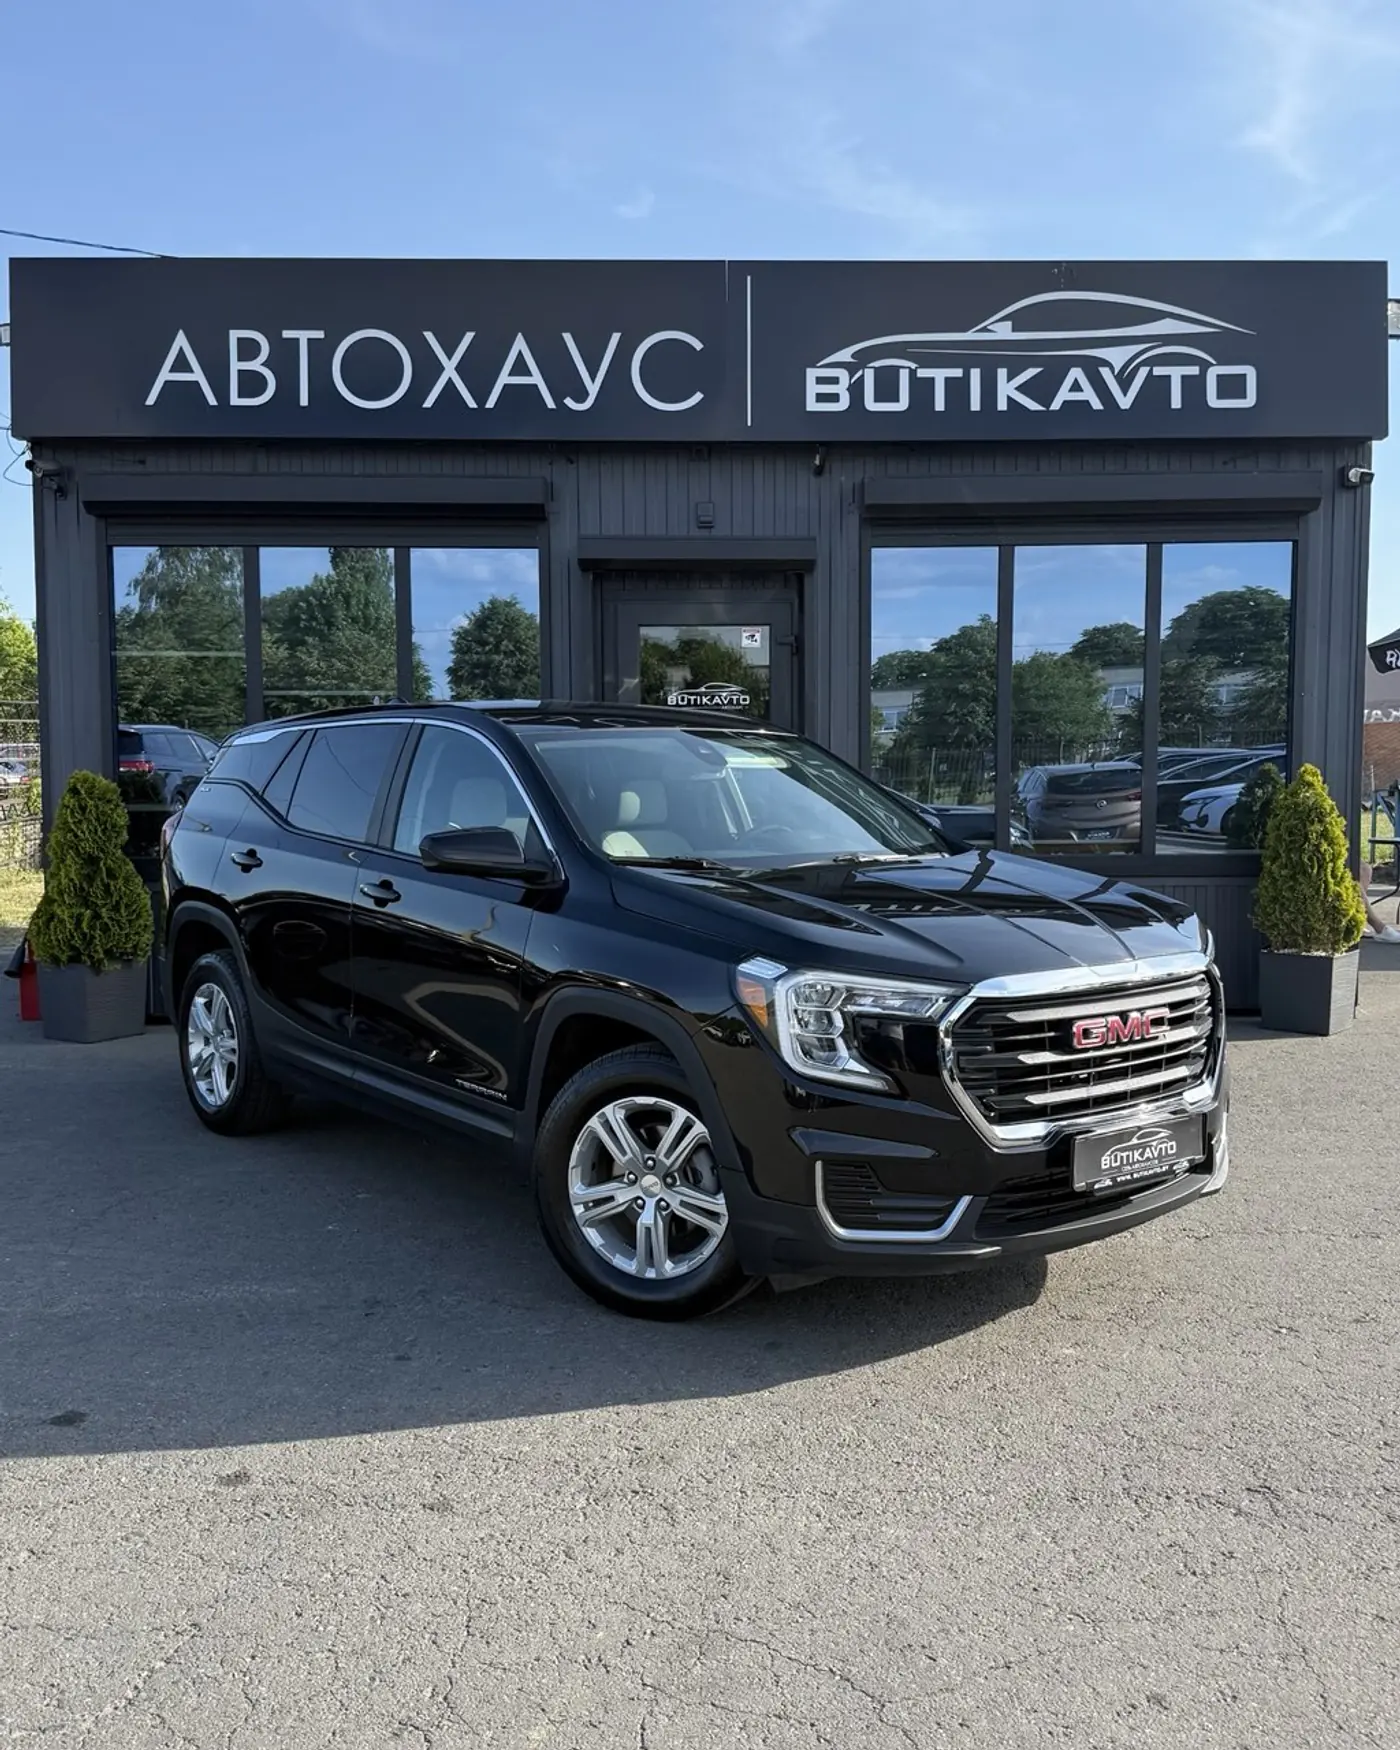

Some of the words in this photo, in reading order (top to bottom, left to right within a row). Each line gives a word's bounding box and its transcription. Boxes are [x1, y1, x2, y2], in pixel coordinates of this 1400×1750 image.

[144, 328, 705, 412] АВТОХАУС
[805, 364, 1258, 412] BUTIKAVTO
[667, 695, 751, 706] BUTIKAVTO
[1073, 1007, 1171, 1049] GMC
[1101, 1141, 1177, 1170] BUTIKAVTO
